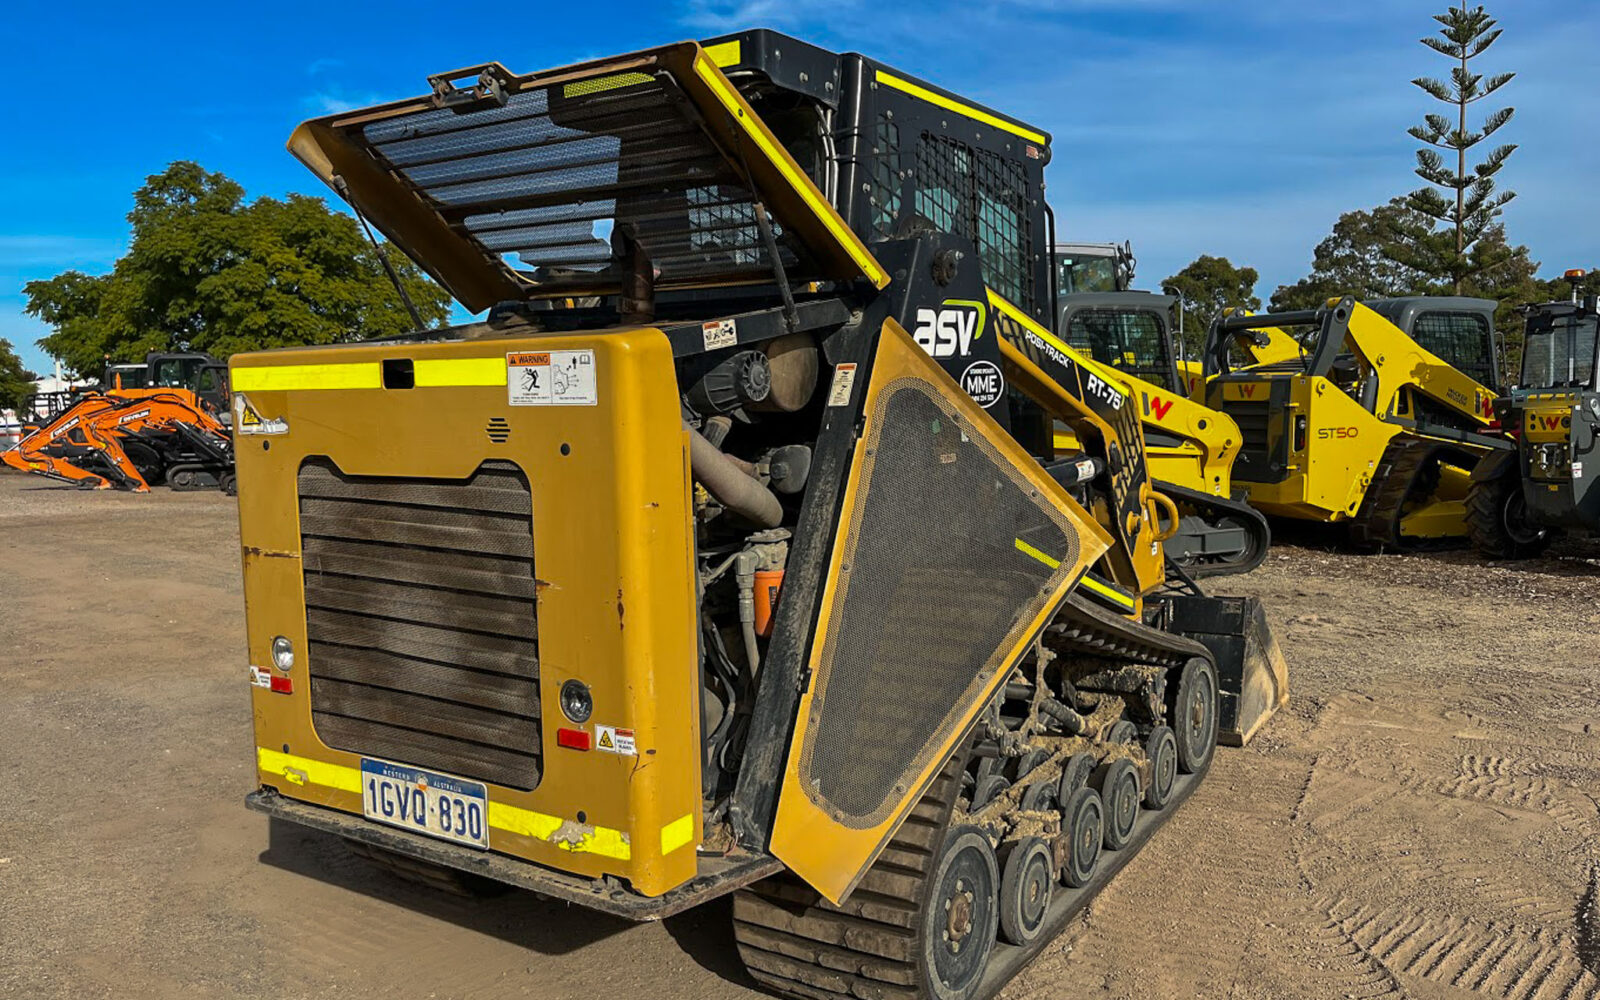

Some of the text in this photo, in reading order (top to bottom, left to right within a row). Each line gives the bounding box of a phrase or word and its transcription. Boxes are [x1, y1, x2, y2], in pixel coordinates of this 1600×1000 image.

[519, 355, 548, 364] WARNING
[1025, 330, 1069, 368] POSI-TRACK
[967, 375, 998, 394] MME
[1087, 373, 1121, 410] RT-75
[1318, 427, 1359, 439] ST50
[383, 768, 462, 793] WESTERN AUSTRALIA
[369, 778, 482, 840] 1GVQ 830
